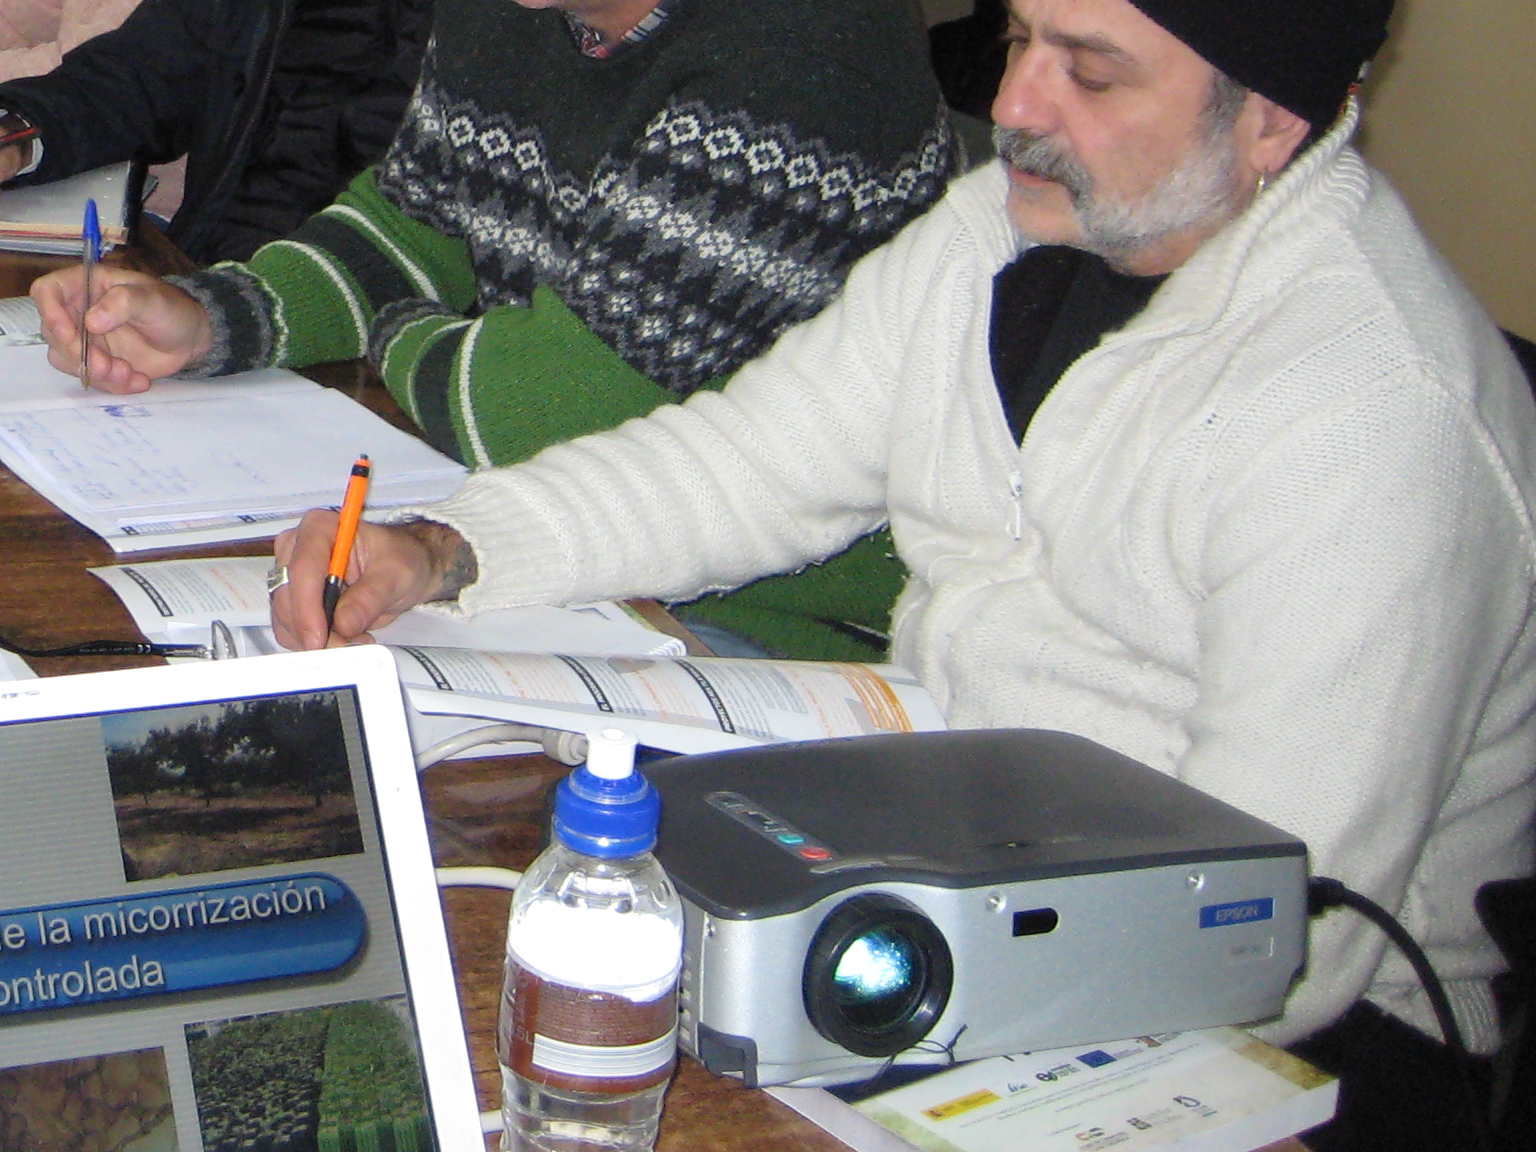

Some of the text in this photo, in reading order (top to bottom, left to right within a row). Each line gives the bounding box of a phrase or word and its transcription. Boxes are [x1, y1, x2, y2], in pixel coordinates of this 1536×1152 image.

[37, 911, 72, 946] la
[83, 880, 326, 940] micorrización
[1215, 905, 1258, 922] EPSON
